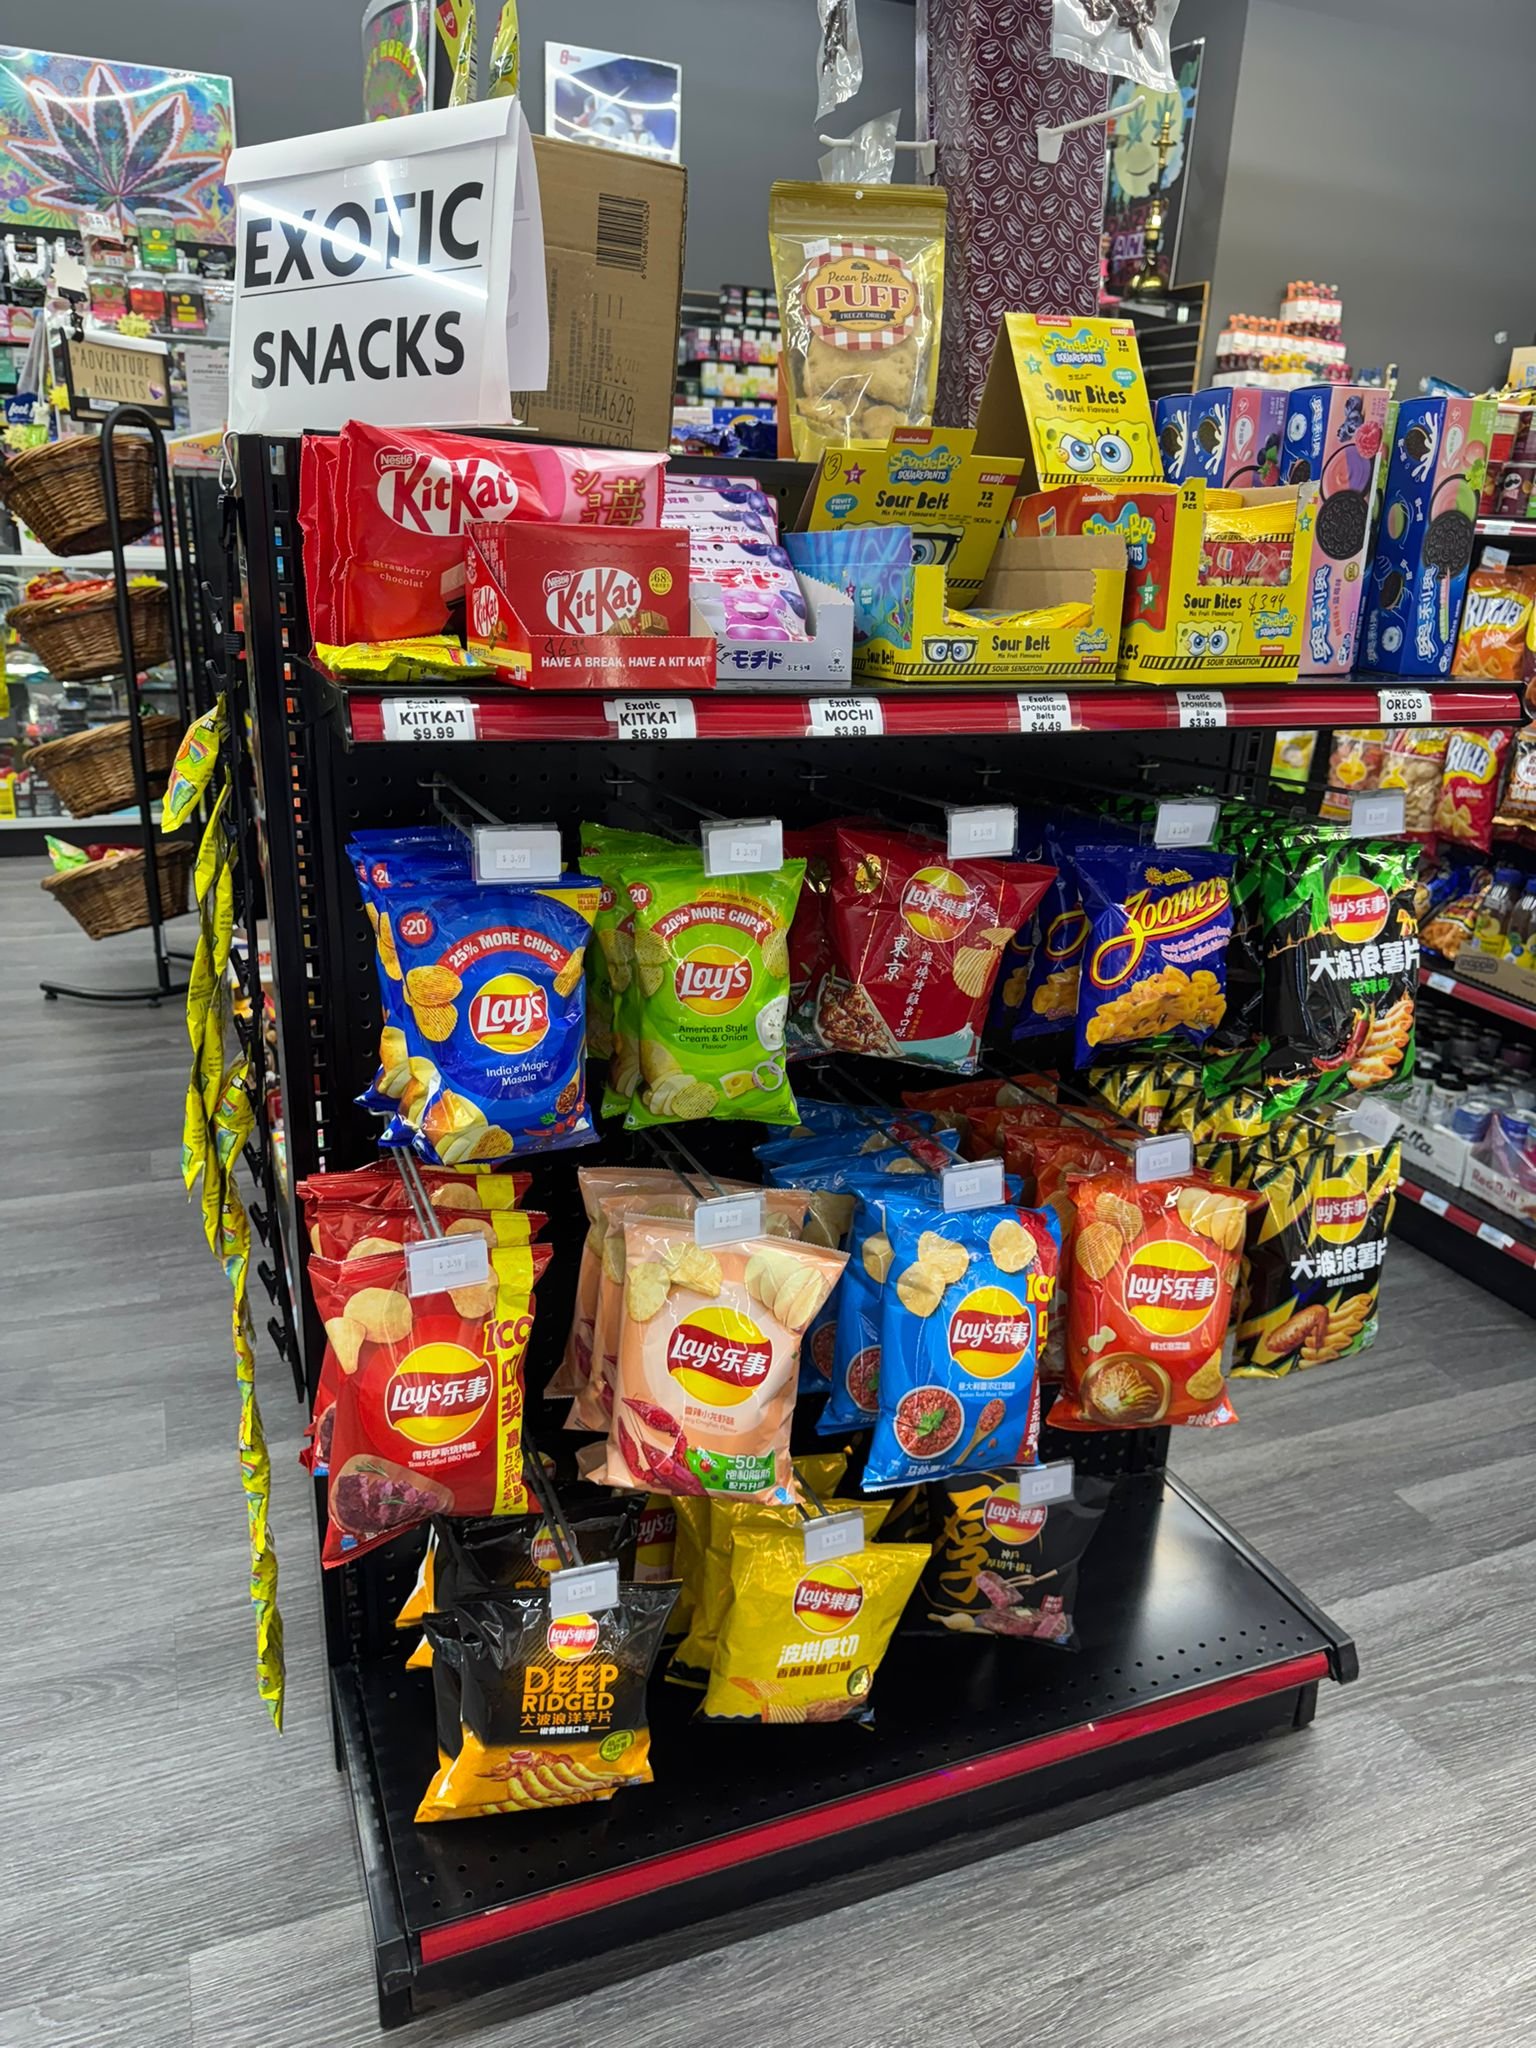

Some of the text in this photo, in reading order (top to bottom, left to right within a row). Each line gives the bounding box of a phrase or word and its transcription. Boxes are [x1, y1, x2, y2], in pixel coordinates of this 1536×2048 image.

[244, 181, 484, 289] EXOTIC
[828, 271, 895, 284] Pecan Brittle
[815, 284, 910, 310] PUFF
[251, 310, 465, 389] SNACKS
[1117, 339, 1127, 347] 12
[79, 349, 151, 379] ADVENTURE
[93, 376, 147, 400] AWAITS
[1044, 382, 1127, 405] Sour Bites
[1069, 405, 1085, 413] Fruit
[1087, 406, 1120, 414] Flavoured
[380, 454, 413, 466] Nestlé
[888, 452, 963, 472] SpongeBob
[896, 469, 948, 481] SQUAREPANTS
[392, 455, 514, 534] KitKat
[603, 478, 646, 526] 苺
[875, 490, 950, 510] Sour Belt
[980, 491, 994, 501] 12
[1183, 491, 1196, 502] 12
[830, 503, 852, 511] TWIST
[892, 509, 907, 517] Fruit
[907, 510, 937, 518] Flavoured
[1182, 502, 1197, 510] PCS
[372, 559, 433, 578] Strawberry
[379, 571, 424, 588] chocolat
[653, 572, 668, 583] 68
[556, 568, 639, 634] KitKat
[1183, 593, 1242, 610] Sour Bites
[991, 635, 1051, 651] Sour Belt
[541, 656, 571, 668] HAVE
[574, 656, 583, 668] A
[585, 656, 626, 670] BREAK,
[629, 656, 656, 668] HAVE
[658, 656, 666, 668] A
[669, 656, 685, 668] KIT
[731, 649, 784, 671] モチド
[867, 648, 895, 665] Sour Belt
[1206, 657, 1261, 667] SOUR SENSATION
[828, 699, 861, 708] Exotic
[1028, 695, 1054, 703] Exotic
[1187, 693, 1211, 701] Exotic
[1386, 698, 1423, 710] OREOS
[625, 701, 661, 711] Exotic
[1022, 704, 1067, 712] SPONGEBOB
[399, 709, 466, 726] KITKAT
[619, 711, 678, 727] KITKAT
[824, 709, 874, 722] MOCHI
[1189, 718, 1217, 728] $3.99
[1393, 711, 1417, 721] $3.99
[413, 726, 455, 741] $9.99
[631, 727, 668, 740] $6.99
[833, 725, 867, 736] $3.99
[1031, 721, 1062, 732] $4.49
[629, 888, 647, 903] 20
[661, 906, 765, 935] 20% MORE CHIPS
[448, 931, 561, 969] 25% MORE CHIPS
[884, 934, 910, 982] 東京
[1309, 937, 1420, 983] 大波浪薯片
[680, 961, 749, 1001] Lay's
[477, 992, 544, 1037] Lay's
[678, 1023, 749, 1035] American Style
[678, 1033, 749, 1043] Cream & Onion
[486, 1060, 550, 1078] India's Magic
[501, 1073, 537, 1087] Masala
[1289, 1236, 1389, 1281] 大波浪薯片
[1127, 1273, 1217, 1304] Lay's乐事
[952, 1318, 1030, 1348] Lay's乐事
[670, 1332, 770, 1377] Lay's乐事
[390, 1375, 489, 1414] Lay's乐事
[426, 1457, 447, 1466] Grilled
[447, 1454, 461, 1463] BBQ
[461, 1450, 481, 1460] Flavor
[796, 1586, 862, 1612] Lay's樂事
[523, 1663, 619, 1694] DEEP
[521, 1691, 615, 1713] RIDGED
